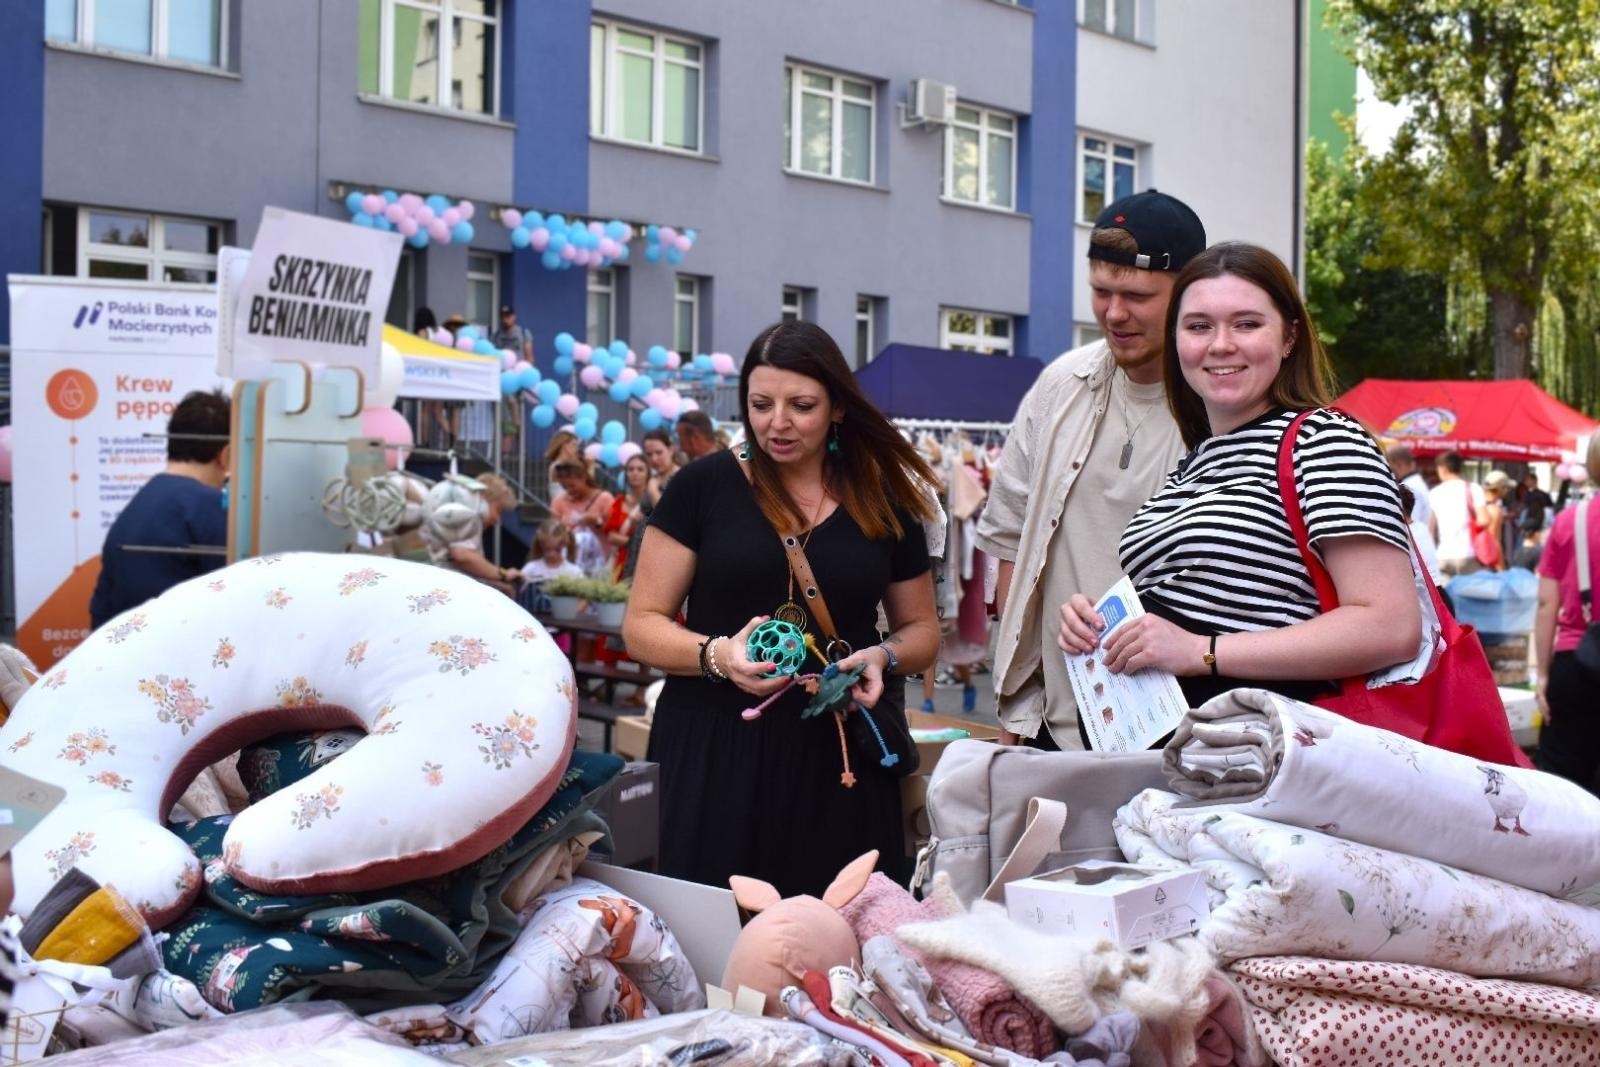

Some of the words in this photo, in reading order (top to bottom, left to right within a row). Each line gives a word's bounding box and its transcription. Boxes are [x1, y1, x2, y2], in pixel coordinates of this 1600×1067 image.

[268, 253, 373, 306] SKRZYNKA
[108, 301, 151, 316] Polski
[155, 303, 191, 317] Bank
[108, 319, 213, 336] Macierzystych
[248, 294, 372, 347] BENIAMINKA
[116, 375, 173, 393] Krew
[116, 400, 178, 421] pępo
[42, 628, 90, 641] Bezce
